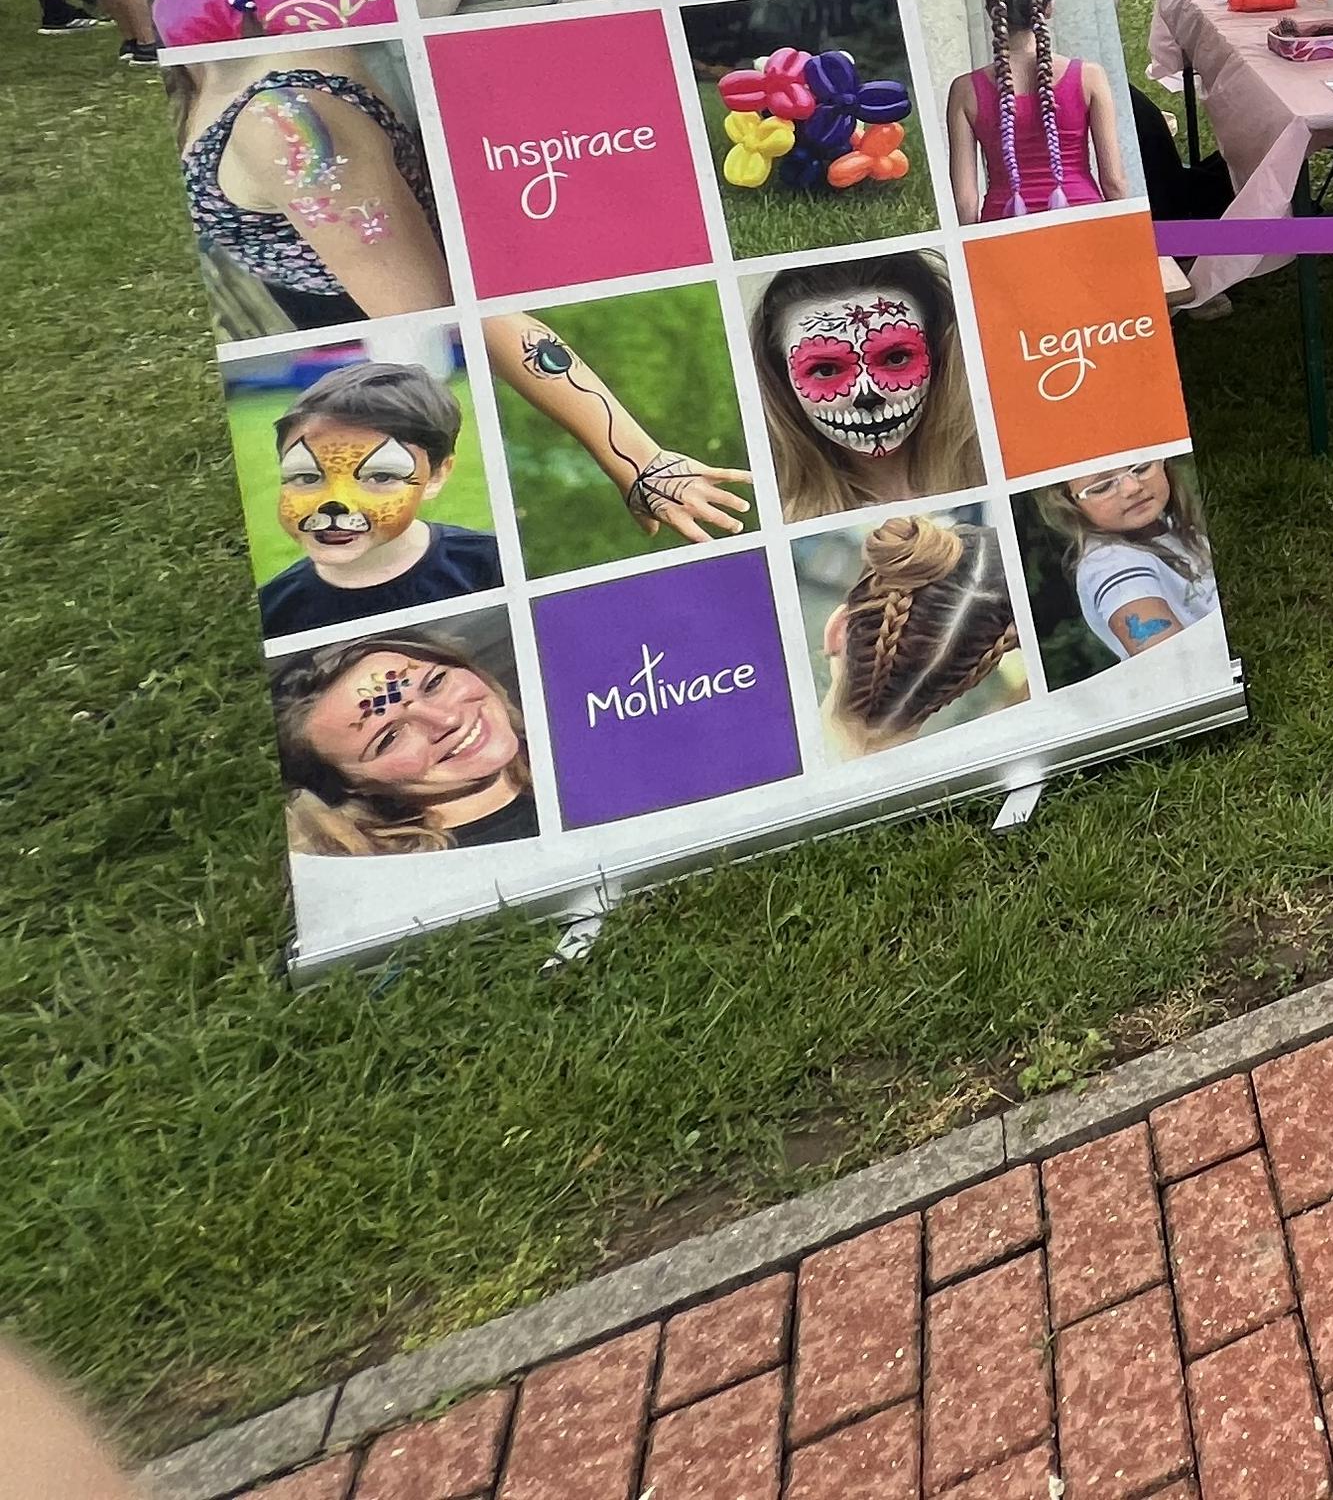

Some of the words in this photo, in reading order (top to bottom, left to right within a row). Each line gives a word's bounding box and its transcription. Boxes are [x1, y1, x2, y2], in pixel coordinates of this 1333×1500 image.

[482, 126, 656, 220] Inspirace
[1019, 316, 1155, 401] Legrace
[587, 643, 756, 728] Motivace
